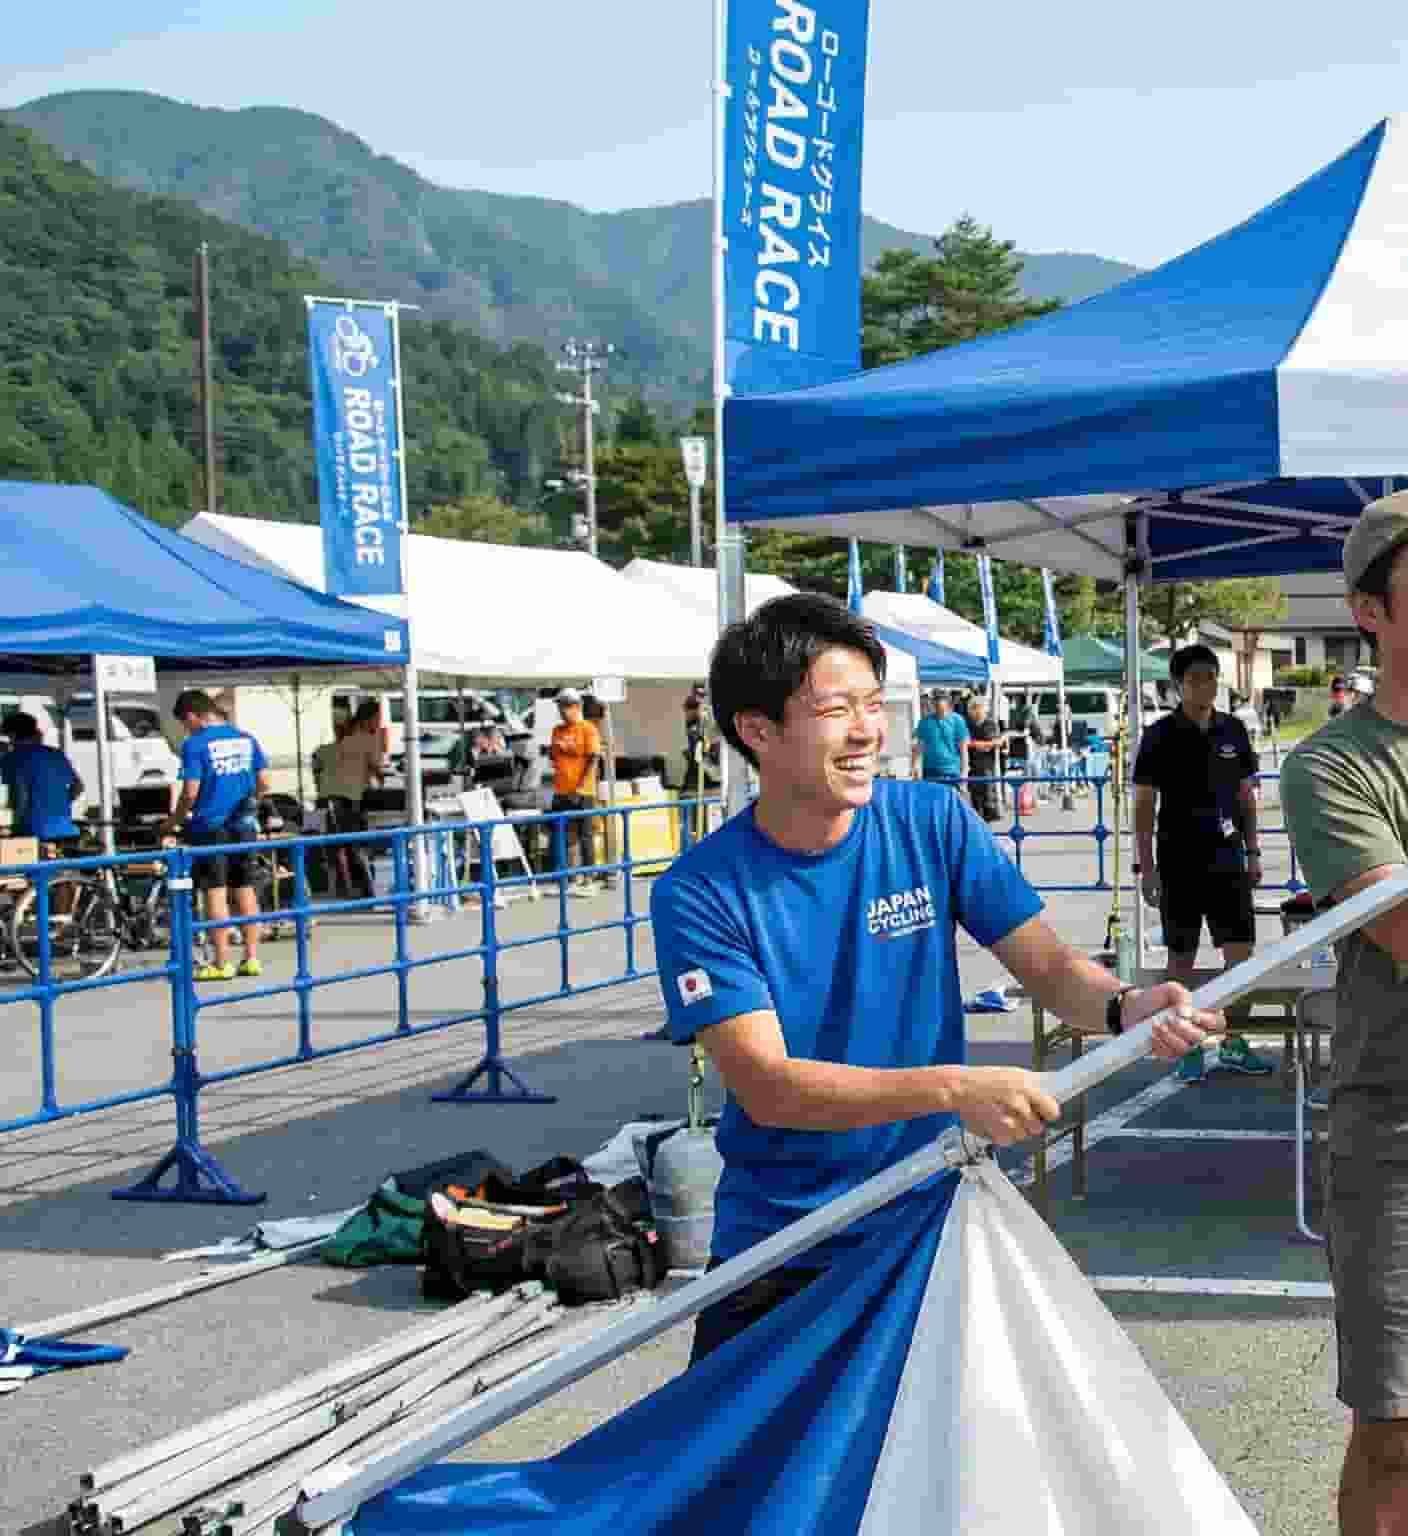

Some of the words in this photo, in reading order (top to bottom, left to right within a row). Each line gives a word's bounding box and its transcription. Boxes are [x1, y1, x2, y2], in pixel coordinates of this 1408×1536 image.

[766, 0, 817, 170] ROAD
[752, 181, 801, 352] RACE
[343, 386, 377, 474] ROAD
[351, 483, 385, 568] RACE
[867, 887, 929, 918] JAPAN
[867, 908, 937, 935] CYCLING
